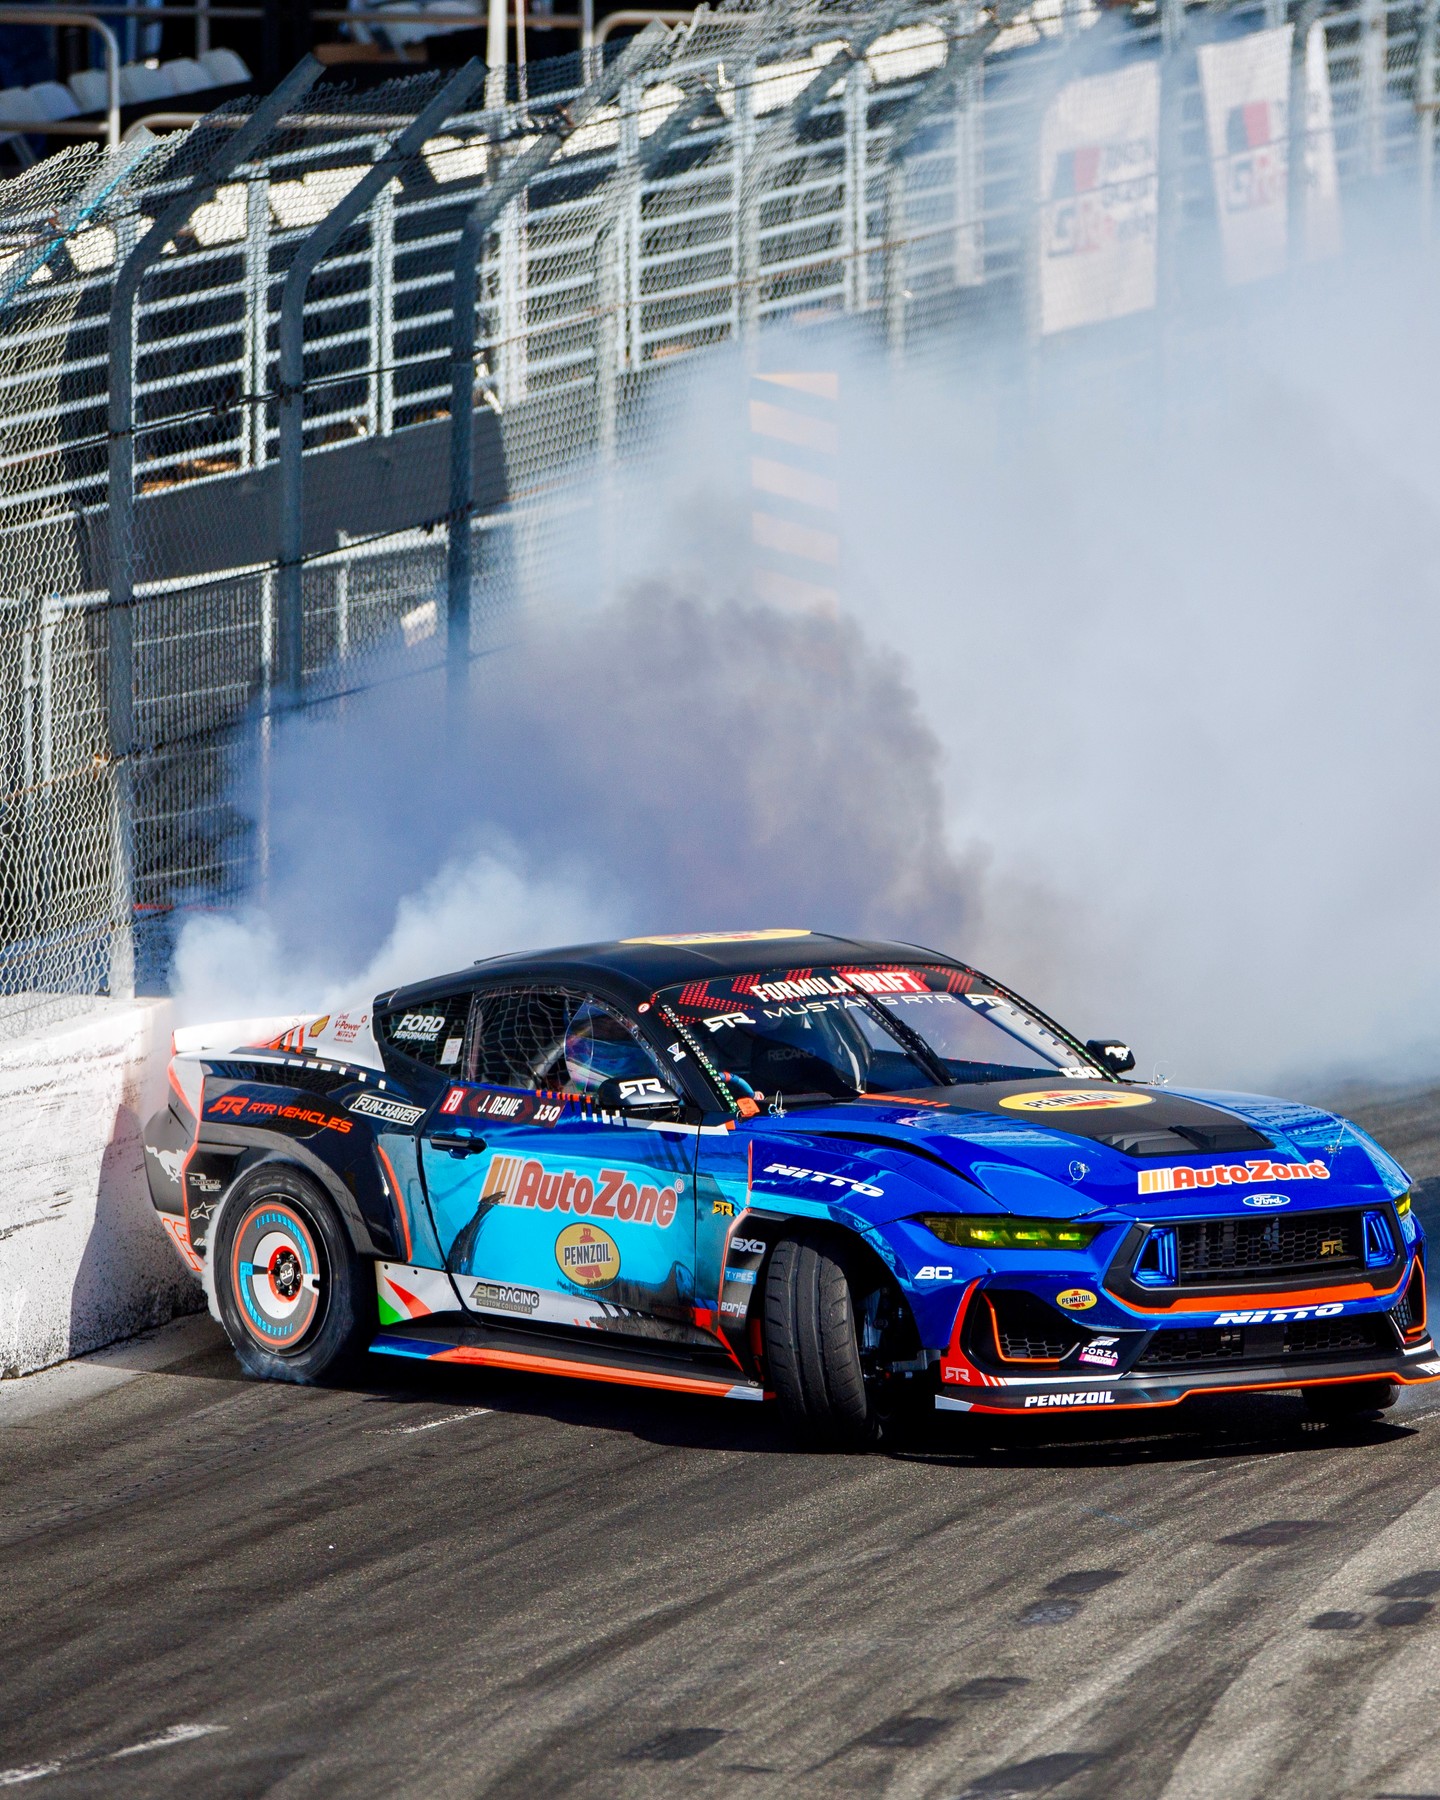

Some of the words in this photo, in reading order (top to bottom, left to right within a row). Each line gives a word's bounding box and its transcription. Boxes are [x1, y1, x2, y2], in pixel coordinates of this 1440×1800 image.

[750, 977, 854, 1002] FORMULA
[848, 971, 921, 992] DRIFT
[763, 994, 898, 1019] MUSTANG
[901, 992, 954, 1005] RTR
[334, 1020, 361, 1030] V-Power
[398, 1014, 445, 1032] FORD
[393, 1031, 438, 1041] PERFORMANCE
[768, 1047, 816, 1061] RECARO
[1059, 1066, 1102, 1079] 130
[443, 1089, 463, 1111] FD
[477, 1095, 490, 1112] J.
[488, 1096, 523, 1116] DEANE
[533, 1104, 560, 1122] 130
[1023, 1092, 1125, 1110] PENNZOIL
[248, 1102, 278, 1115] RTR
[277, 1105, 353, 1133] VEHICLES
[355, 1099, 420, 1122] FUN-HAVER
[764, 1163, 885, 1198] NITTO
[1172, 1161, 1329, 1189] AutoZone
[514, 1162, 679, 1227] AutoZone
[1253, 1195, 1283, 1206] Ford
[563, 1243, 614, 1266] PENNZOIL
[914, 1266, 953, 1280] BC
[499, 1288, 539, 1306] RACING
[1061, 1294, 1093, 1305] PENNZOIL
[478, 1300, 500, 1309] CUSTOM
[501, 1303, 532, 1314] COILOVERS
[1213, 1303, 1344, 1325] NITTO
[1082, 1346, 1118, 1359] FORZA
[1025, 1391, 1115, 1408] PENNZOIL
